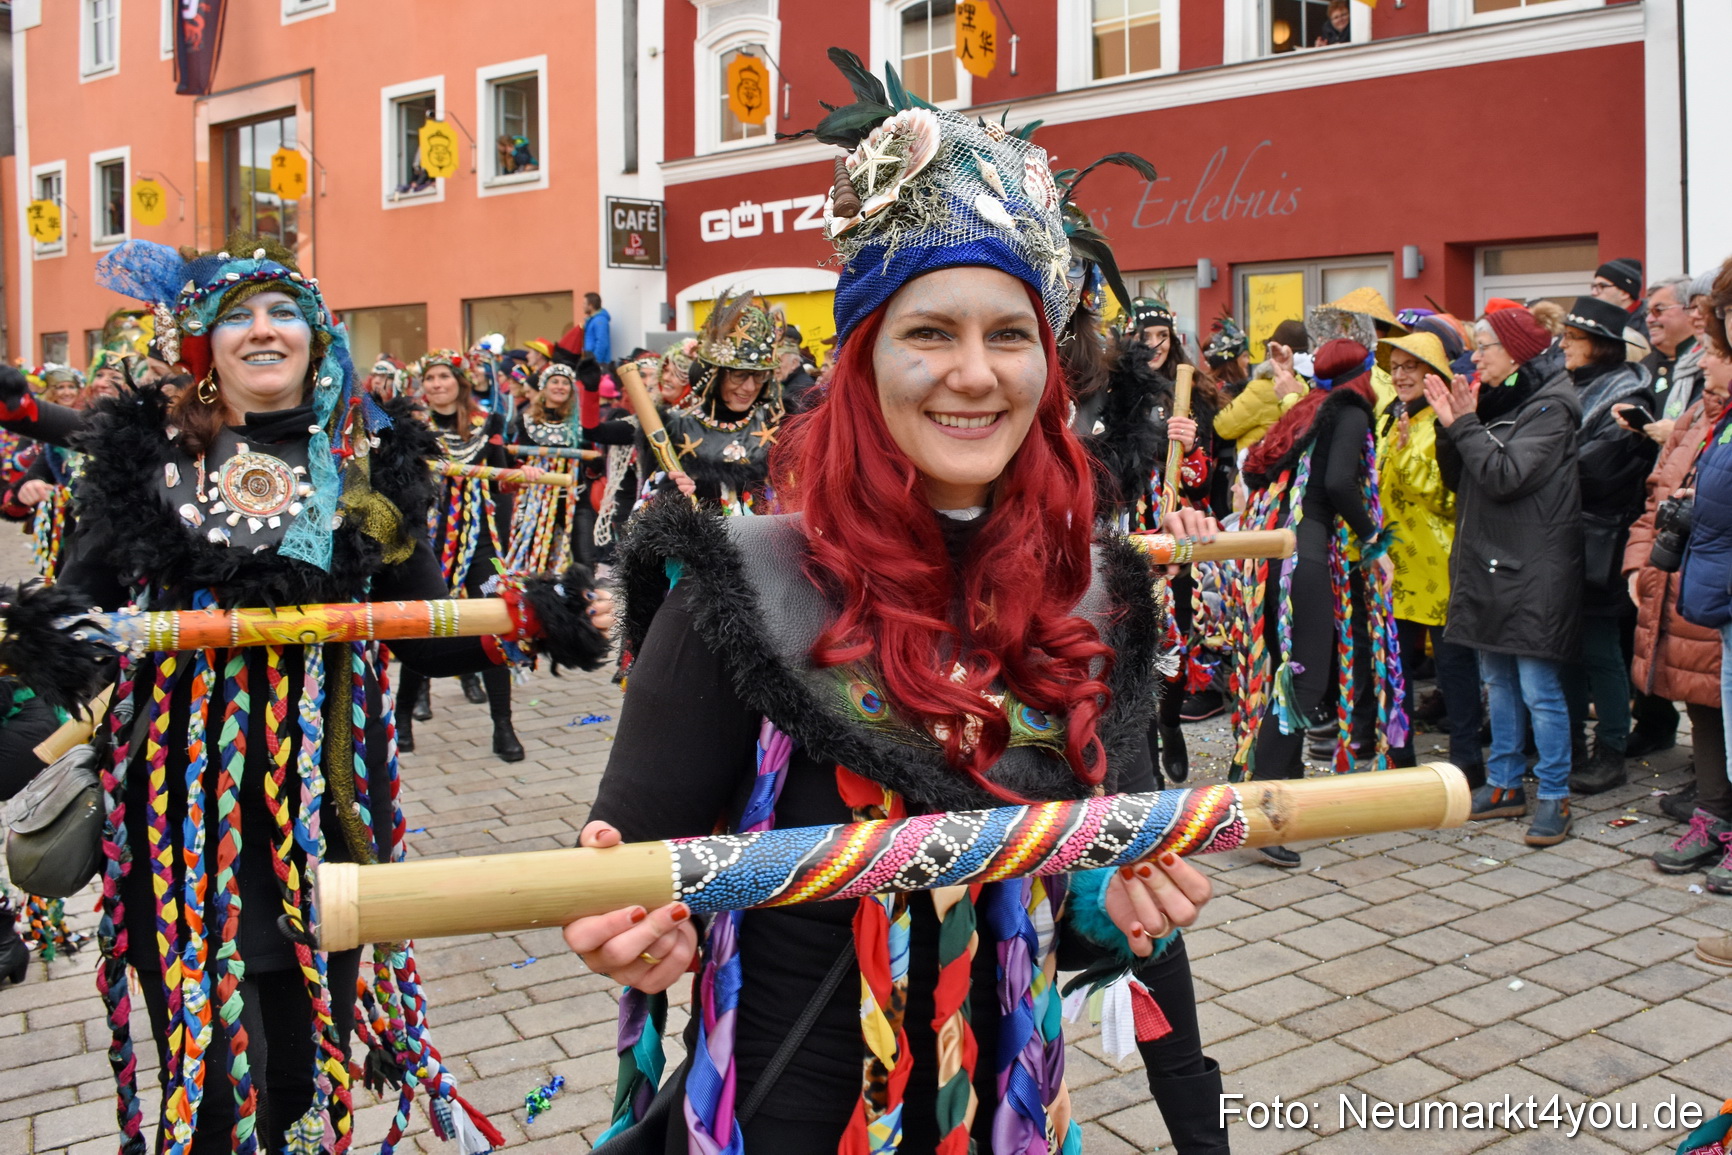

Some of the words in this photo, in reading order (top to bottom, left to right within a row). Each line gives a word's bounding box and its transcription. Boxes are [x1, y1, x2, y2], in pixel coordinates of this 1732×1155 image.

[1132, 139, 1302, 229] Erlebnis
[614, 206, 657, 232] CAFÉ
[700, 194, 826, 242] GÖTZ
